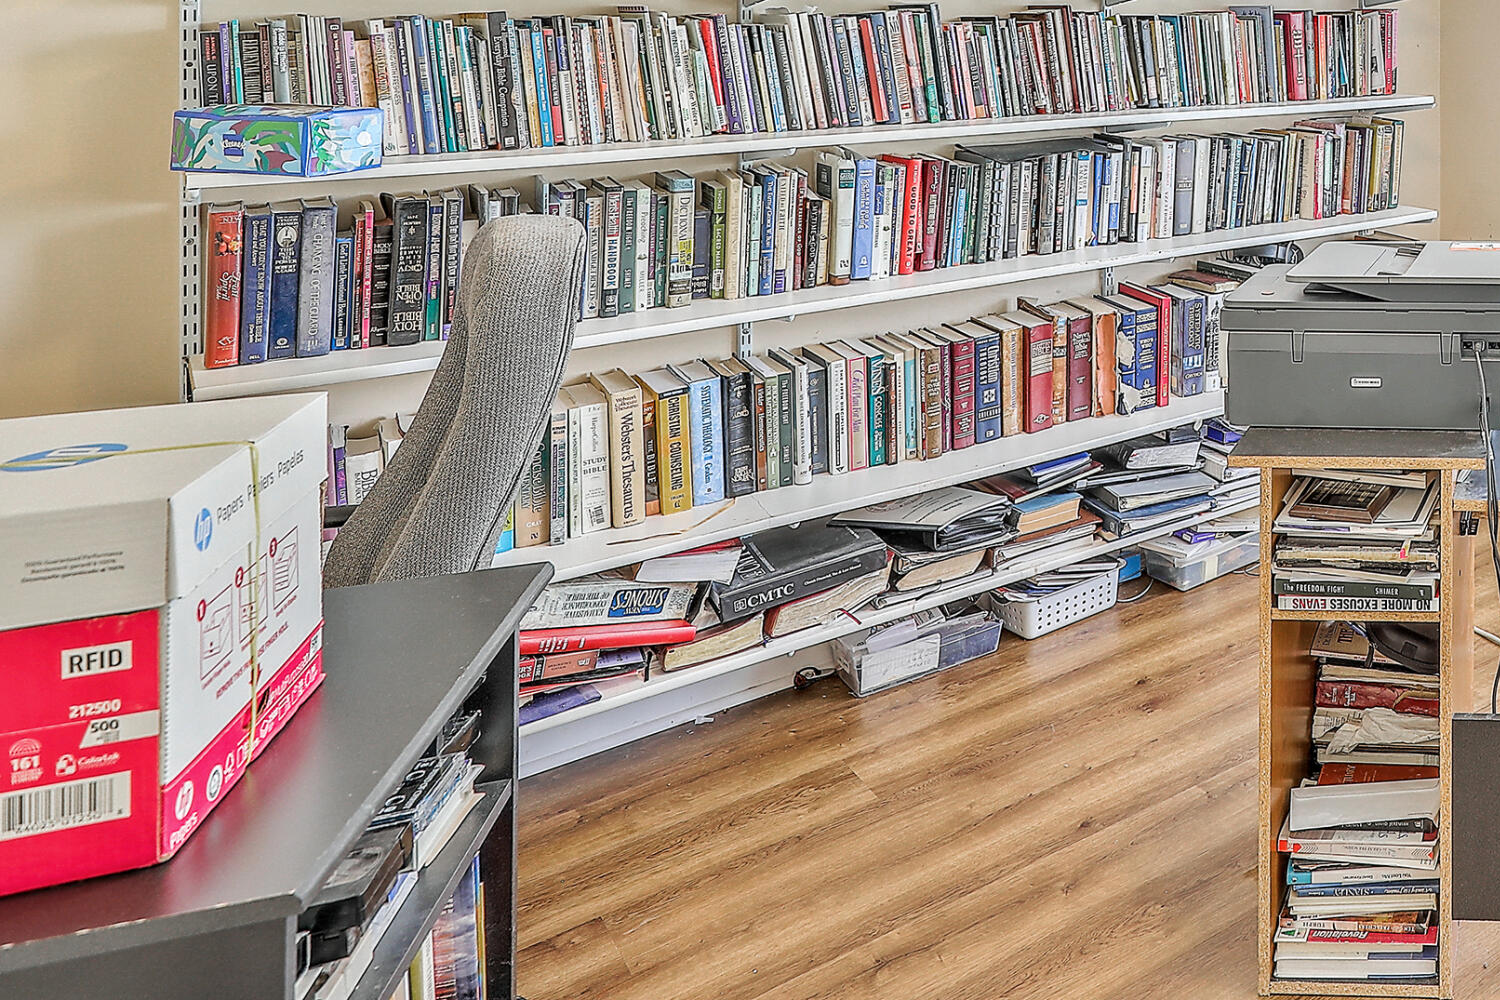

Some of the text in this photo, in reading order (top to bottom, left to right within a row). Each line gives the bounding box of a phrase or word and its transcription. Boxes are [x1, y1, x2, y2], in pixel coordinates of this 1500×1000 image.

[207, 64, 218, 92] UPON
[493, 36, 508, 127] Everyday Bible Companion
[683, 55, 694, 88] Handbook
[689, 101, 699, 126] Writers
[258, 219, 267, 237] WHAT
[625, 207, 633, 230] FREEDOM
[638, 212, 648, 244] Preaching
[679, 197, 691, 240] DICTIONA
[909, 215, 915, 225] TO
[258, 237, 266, 250] YOU
[906, 229, 915, 258] GREAT
[606, 239, 618, 287] HANDBOOK
[220, 272, 232, 301] Spirit
[257, 272, 265, 290] KNOW
[309, 233, 323, 336] CHANGING OF THE GUARD
[337, 243, 348, 317] God's Little Devotional Book
[256, 291, 264, 311] ABOUT
[396, 291, 422, 301] OPEN
[392, 321, 422, 331] HOLY
[393, 311, 423, 322] BIBLE
[1187, 307, 1195, 349] THEOLOGY
[1194, 302, 1202, 350] SYSTEMATIC
[979, 348, 988, 385] THEOLOGY
[987, 345, 1000, 384] Christian
[871, 358, 885, 429] VINE'S CONCISE
[668, 397, 682, 490] CHRISTIAN COUNSELING
[701, 385, 712, 484] SYSTEMATIC THEOLOGY Grudem
[583, 457, 607, 466] STUDY
[583, 465, 607, 475] BIBLE
[620, 412, 636, 519] Webster's Thesaurus
[646, 453, 656, 484] BIBLE
[216, 450, 304, 524] Papers Paiers Papeles
[532, 487, 545, 513] Bible
[613, 588, 671, 608] STRONG'S
[746, 583, 795, 608] CMTC
[1296, 584, 1326, 592] FREEDOM
[1327, 585, 1345, 593] FIGHT
[1375, 587, 1399, 596] SHIMER
[1292, 598, 1431, 610] NO MORE EXCUSES EVANS
[69, 649, 122, 673] RFID
[69, 699, 121, 719] 212500
[90, 719, 119, 734] 500
[10, 756, 40, 772] 161
[1312, 931, 1368, 939] Revelation
